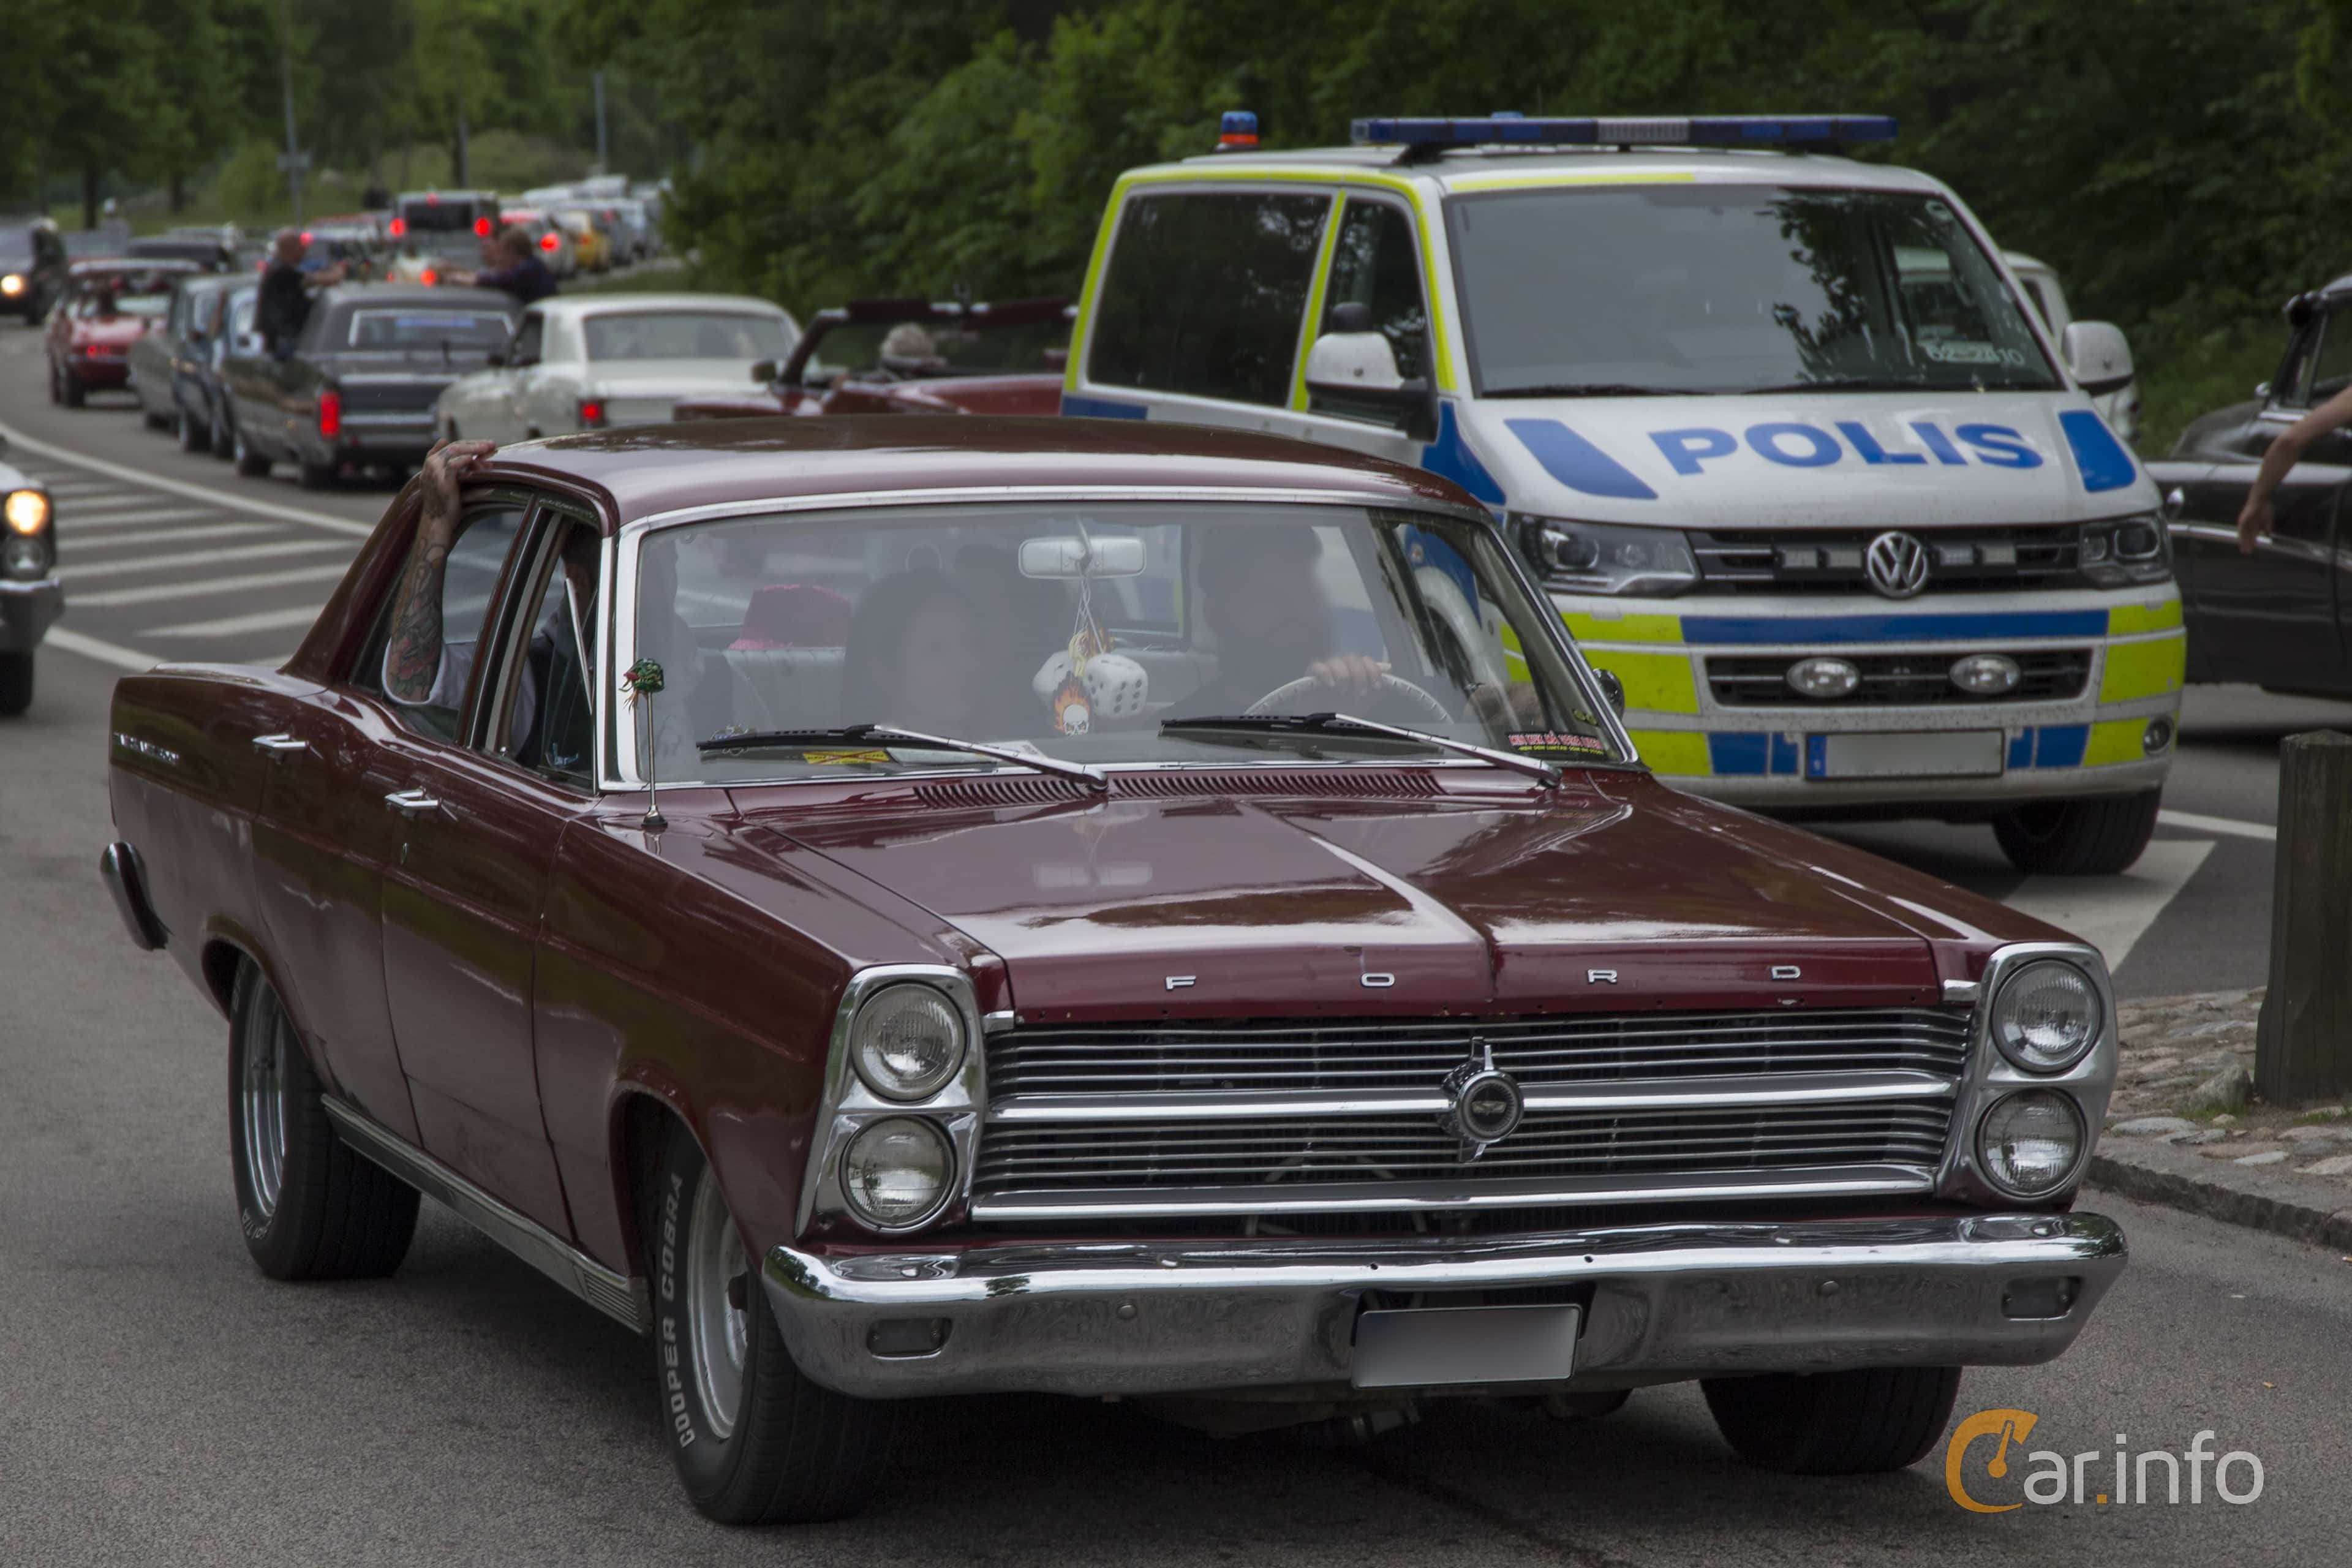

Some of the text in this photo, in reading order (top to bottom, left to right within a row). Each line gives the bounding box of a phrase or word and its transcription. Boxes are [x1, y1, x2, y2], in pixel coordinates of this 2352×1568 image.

[1649, 421, 2043, 476] POLIS
[662, 1172, 696, 1449] COOPER COBRA
